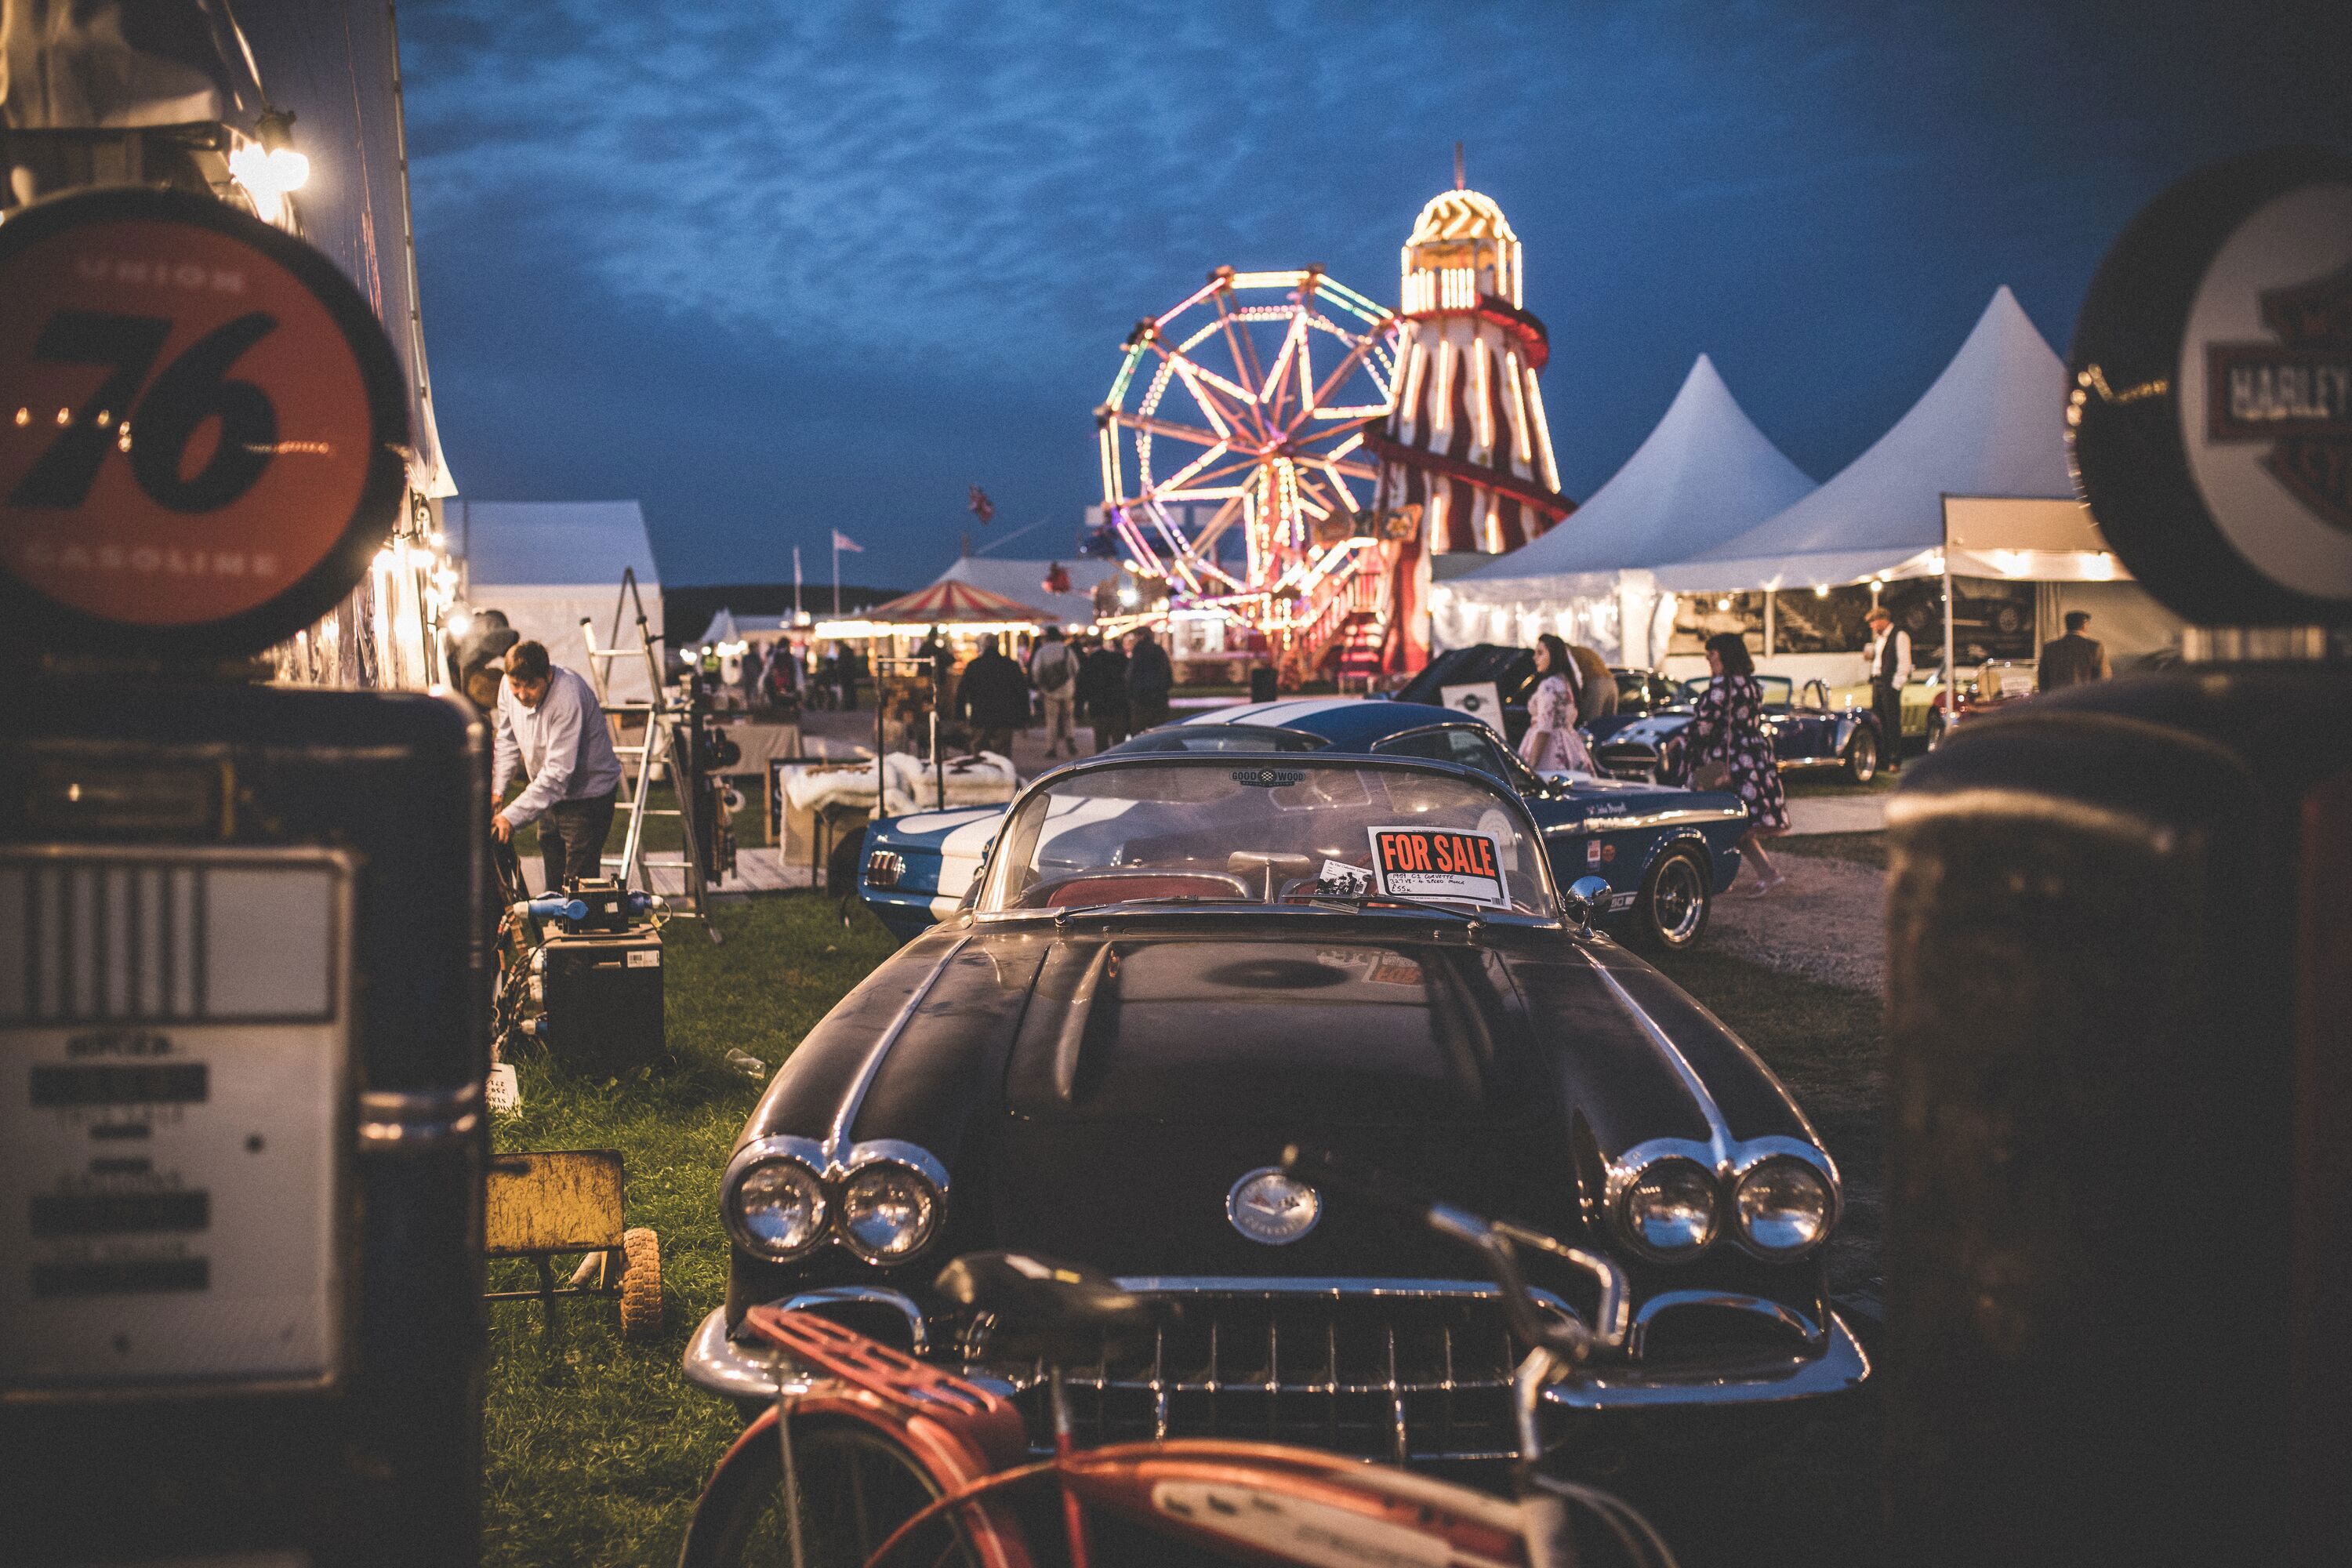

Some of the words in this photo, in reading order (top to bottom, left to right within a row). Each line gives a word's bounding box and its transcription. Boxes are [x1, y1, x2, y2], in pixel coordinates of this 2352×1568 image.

[6, 310, 279, 515] 76
[1232, 771, 1257, 780] GOOD
[1277, 772, 1303, 781] WOOD
[1381, 834, 1432, 871] FOR
[1434, 834, 1496, 877] SALE
